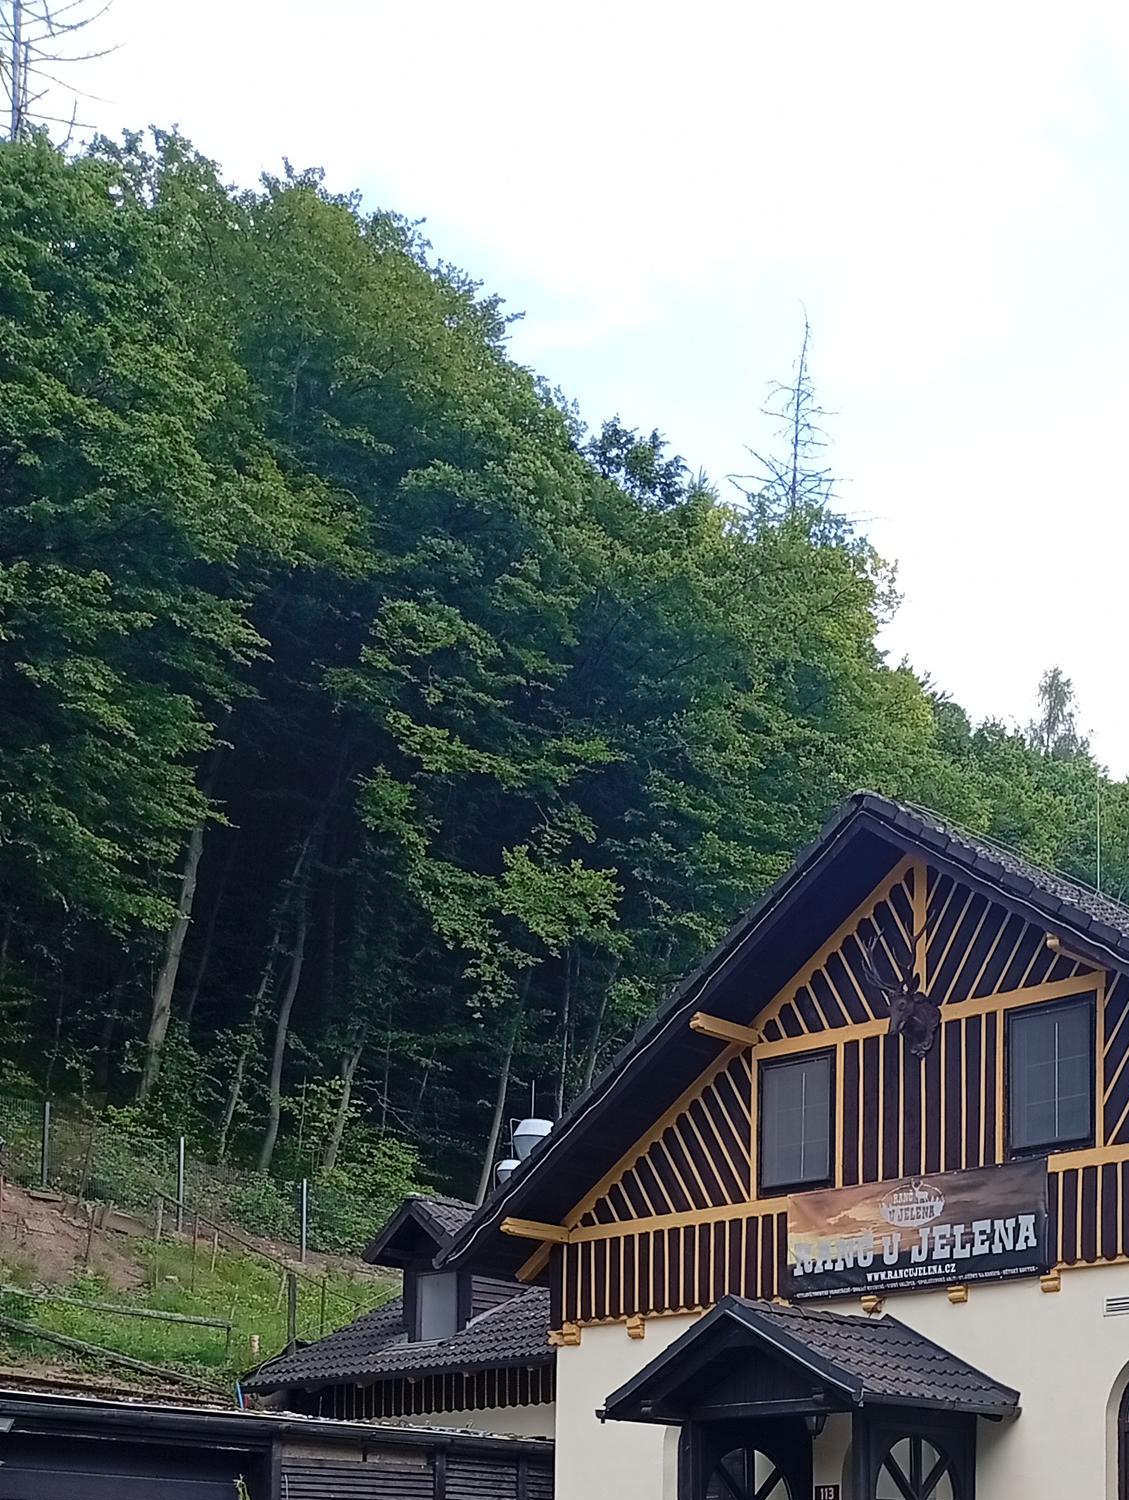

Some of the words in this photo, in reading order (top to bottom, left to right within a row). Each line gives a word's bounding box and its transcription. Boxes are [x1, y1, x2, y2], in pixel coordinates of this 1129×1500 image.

[889, 1208, 895, 1221] U
[898, 1205, 935, 1222] JELENA
[793, 1228, 874, 1277] RANČ
[882, 1232, 901, 1265] U
[911, 1214, 1038, 1264] JELENA
[866, 1263, 957, 1283] WWW.RANCUJELENA.CZ
[820, 1487, 835, 1500] 113
